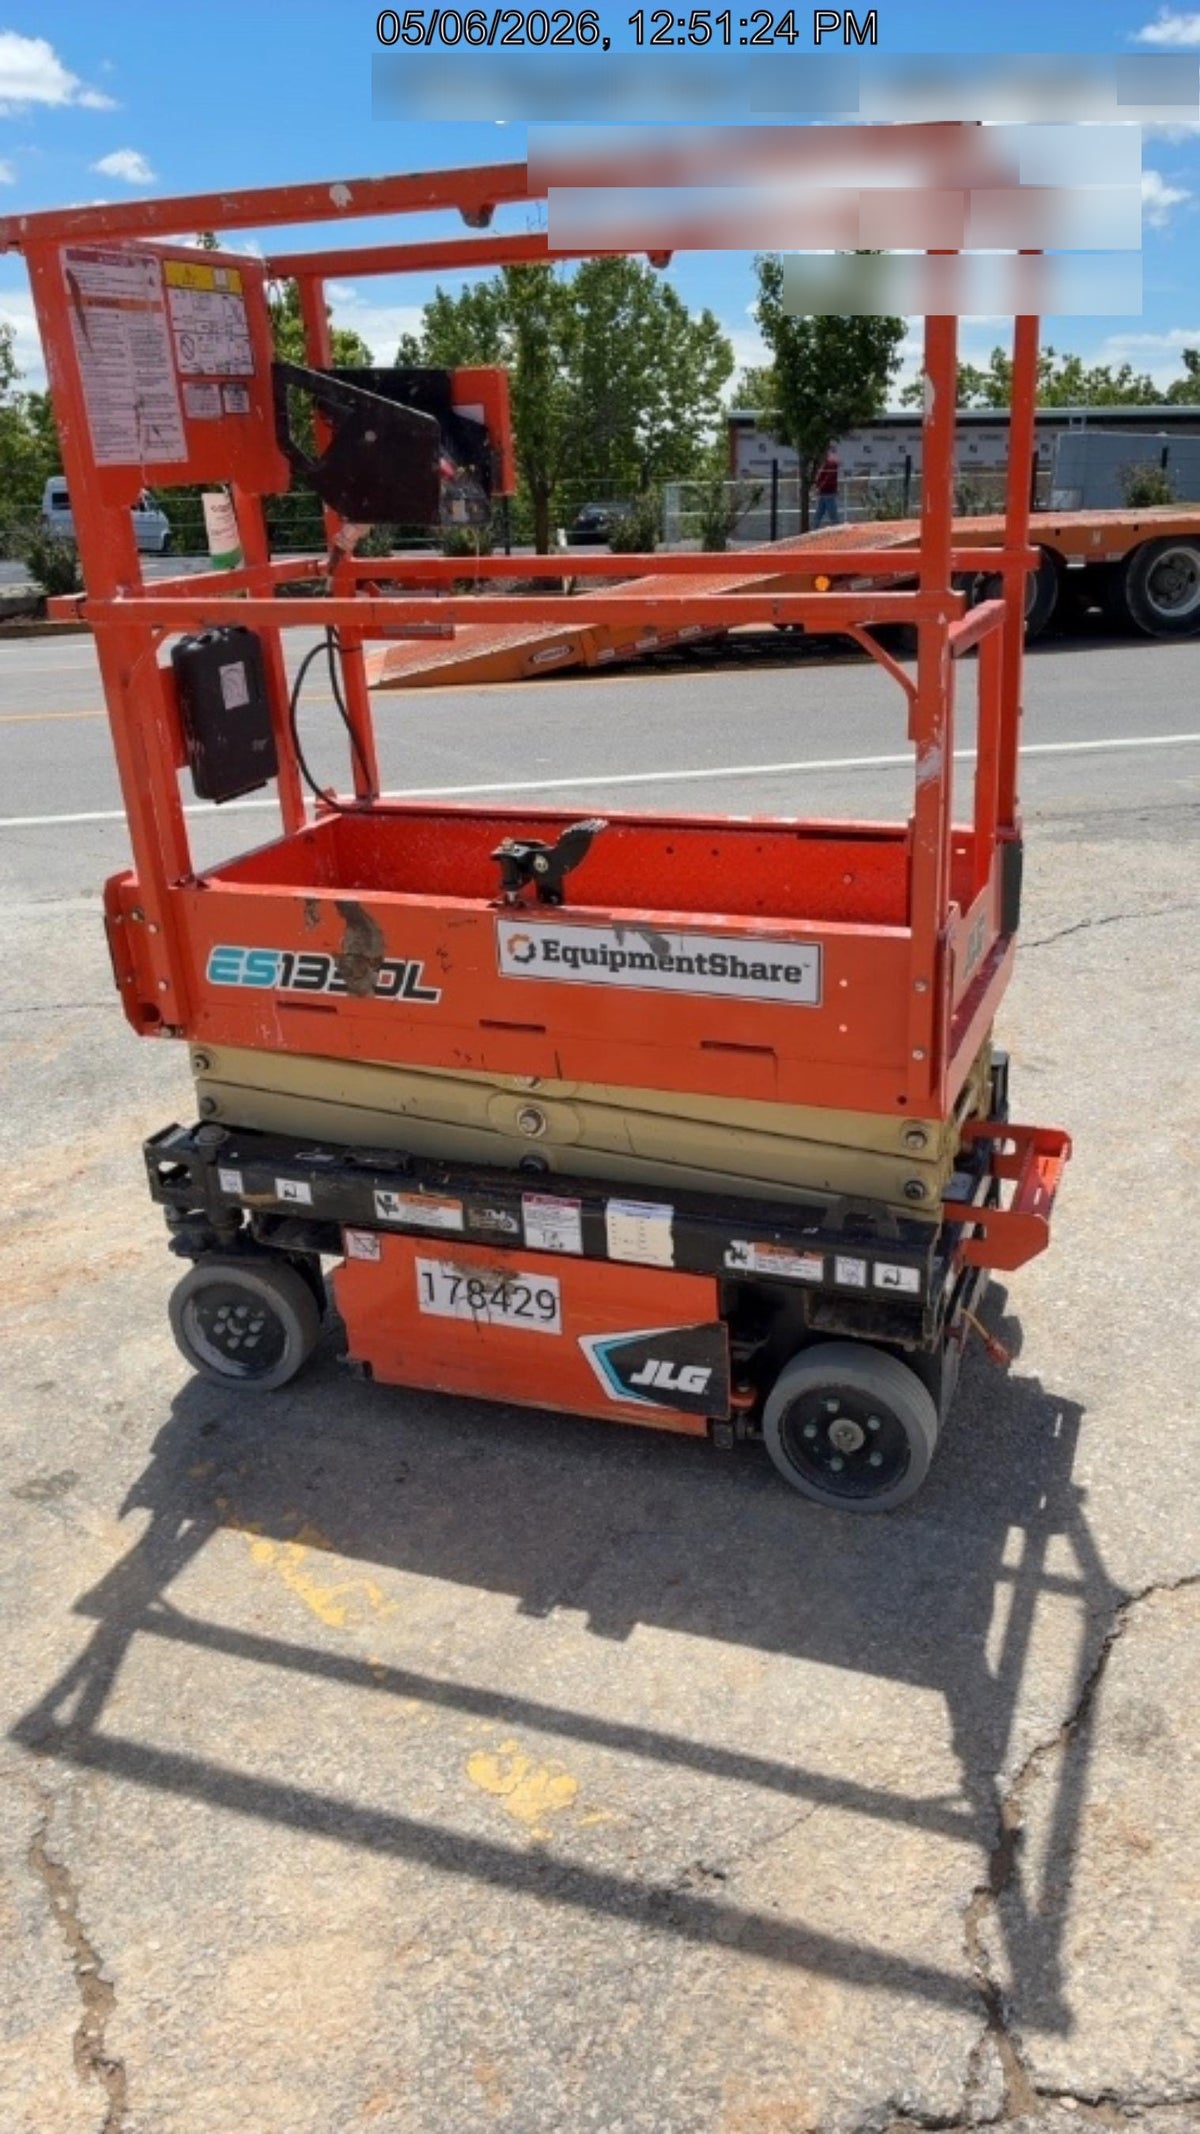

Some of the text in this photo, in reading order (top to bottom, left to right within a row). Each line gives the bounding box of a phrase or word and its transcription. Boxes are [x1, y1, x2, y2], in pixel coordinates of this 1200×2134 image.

[541, 938, 802, 983] EquipmentShare
[421, 1272, 557, 1322] 178429
[630, 1359, 712, 1394] JLG
